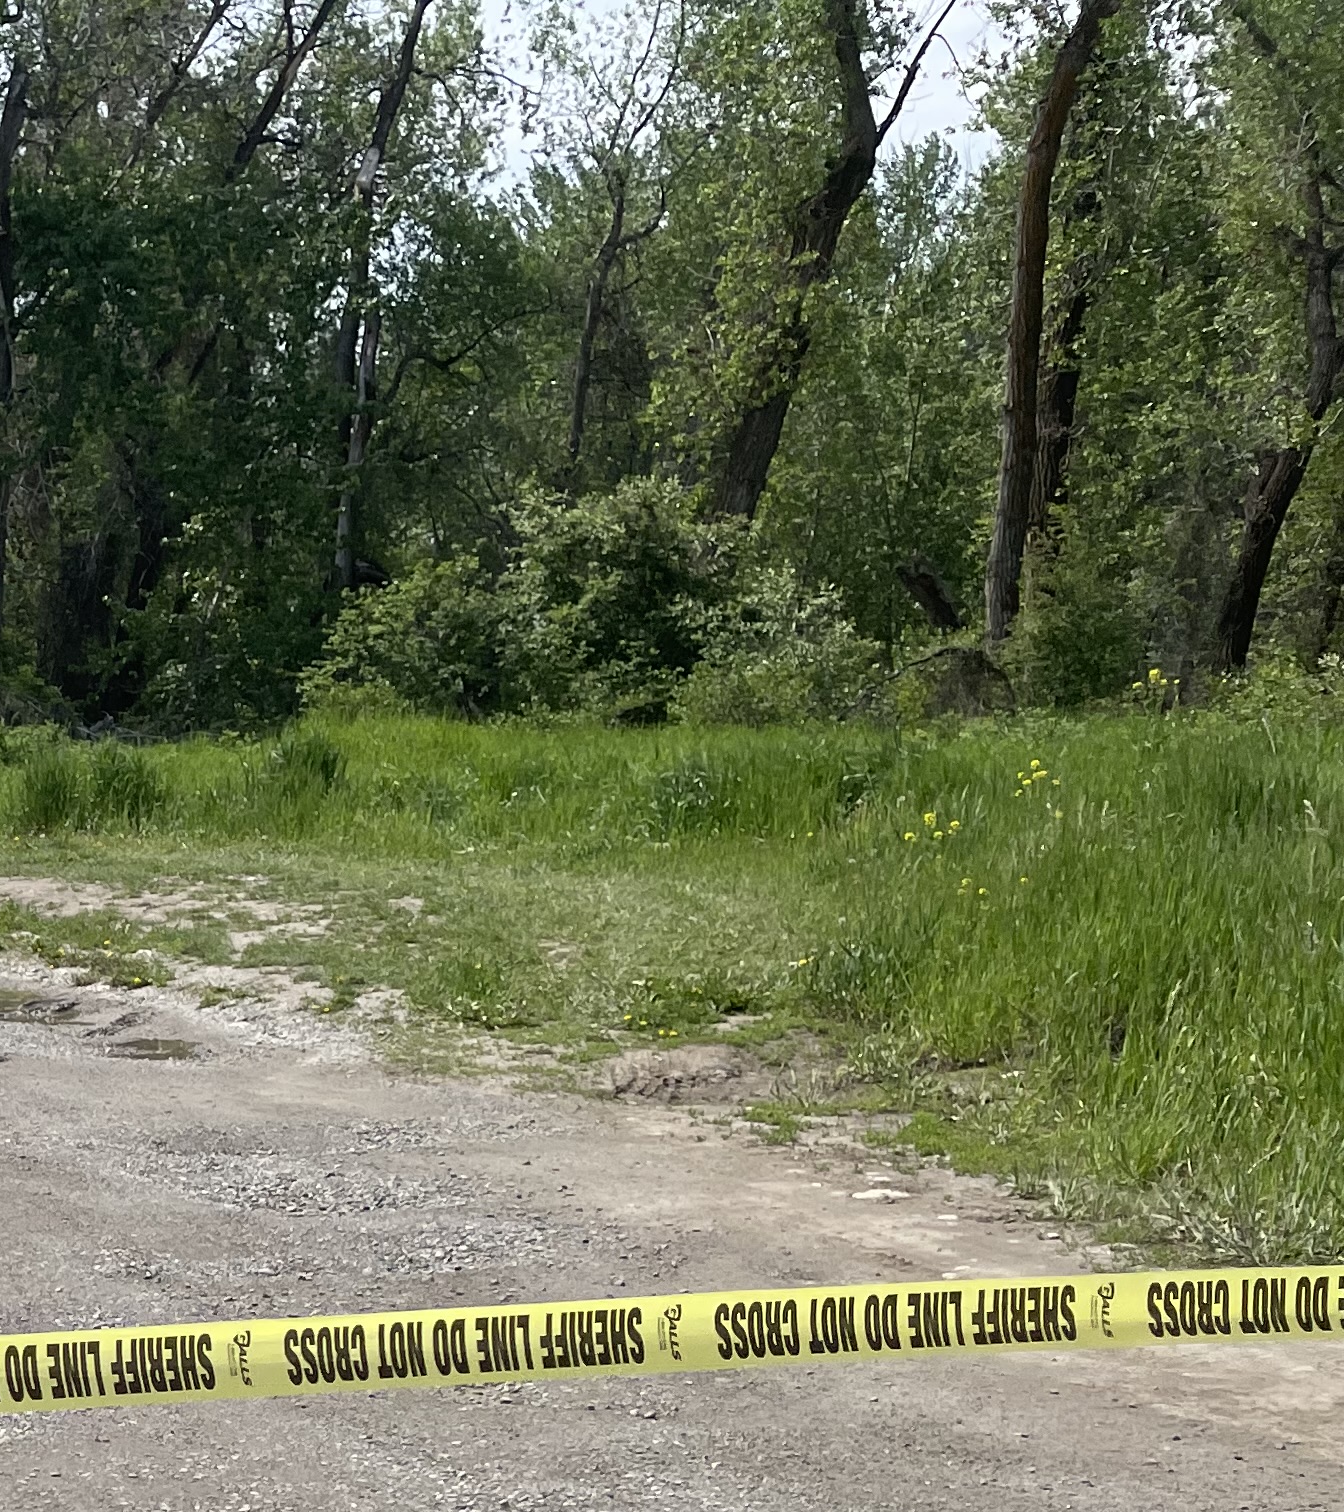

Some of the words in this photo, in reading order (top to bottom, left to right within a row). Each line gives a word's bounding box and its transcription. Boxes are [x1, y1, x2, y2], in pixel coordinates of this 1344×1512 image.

[714, 1299, 800, 1360] CROSS
[809, 1296, 859, 1354] NOT
[863, 1293, 901, 1351] DO
[907, 1290, 965, 1349] LINE
[971, 1284, 1077, 1345] SHERIFF
[1147, 1279, 1232, 1338] CROSS
[1239, 1277, 1291, 1334] NOT
[1295, 1276, 1333, 1333] DO
[112, 1333, 216, 1395] SHERIFF
[284, 1324, 369, 1385] CROSS
[377, 1321, 428, 1379] NOT
[433, 1318, 471, 1376] DO
[475, 1315, 534, 1373] LINE
[540, 1307, 645, 1369] SHERIFF
[5, 1344, 42, 1402] DO
[47, 1341, 106, 1399] LINE
